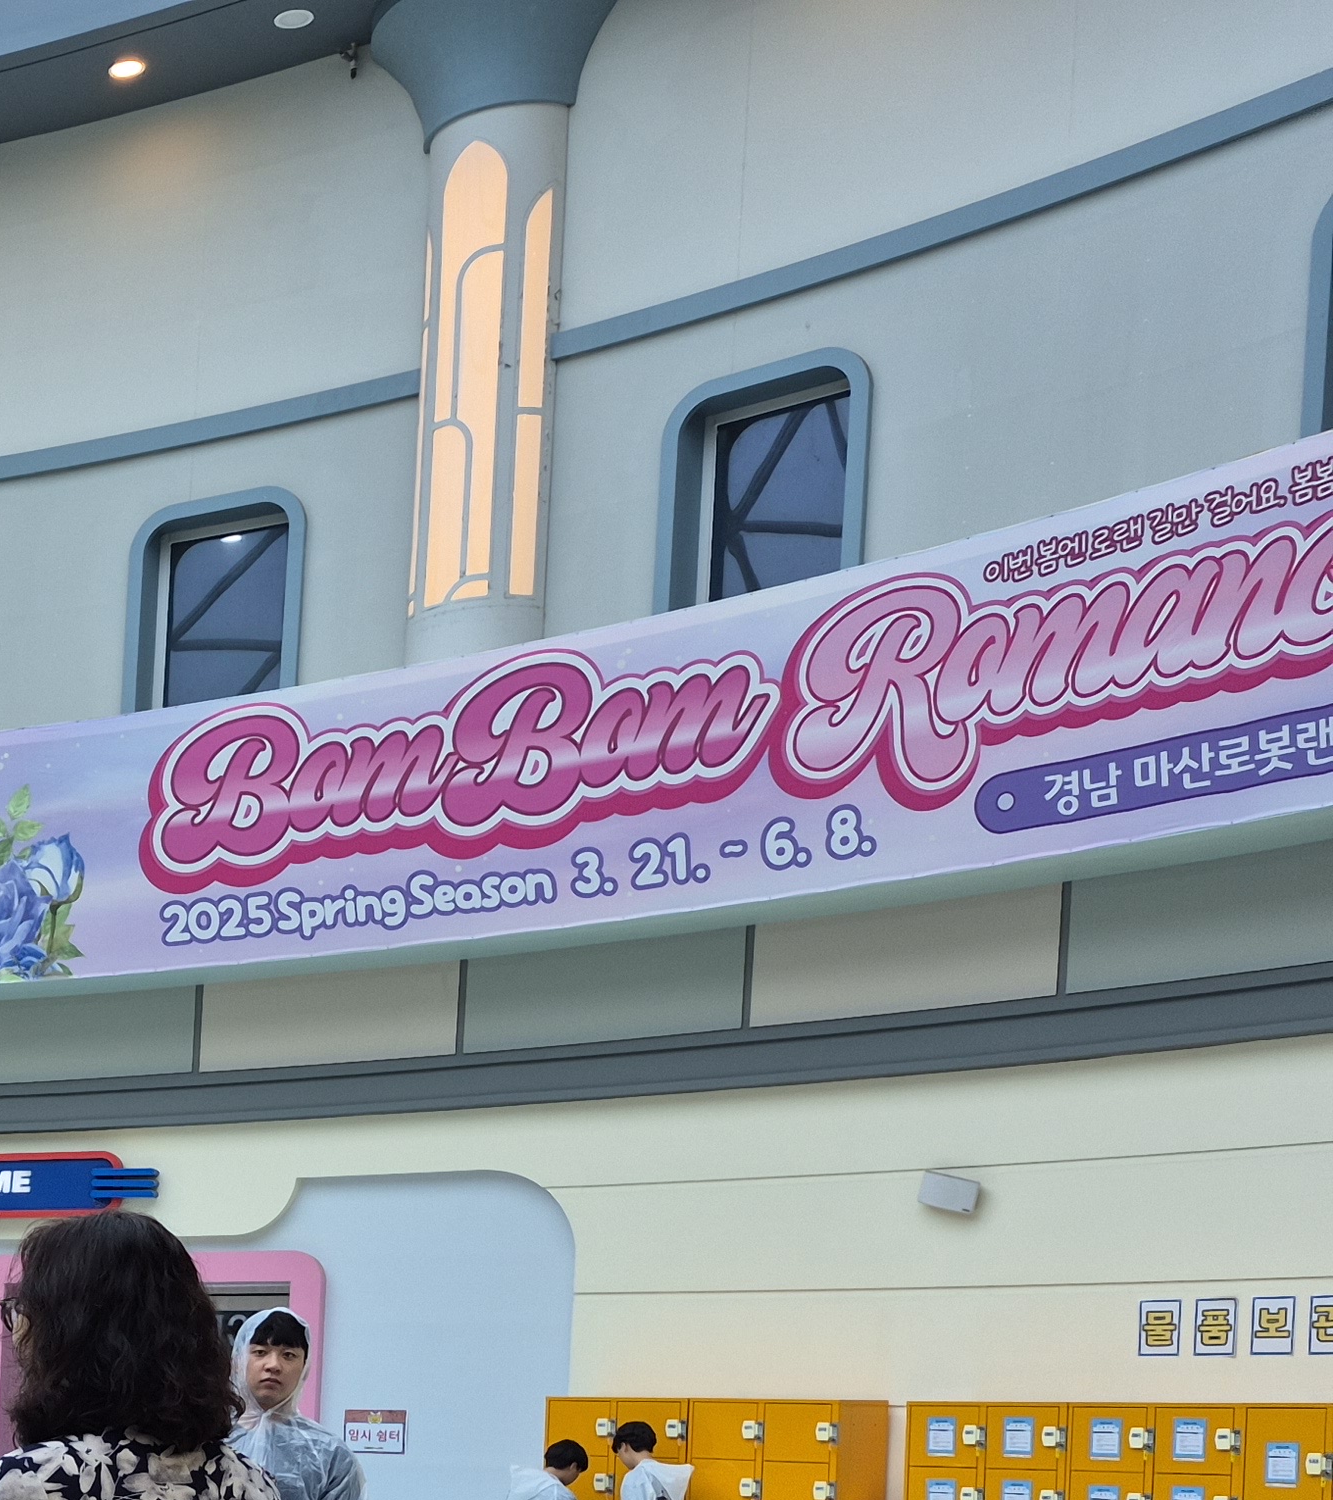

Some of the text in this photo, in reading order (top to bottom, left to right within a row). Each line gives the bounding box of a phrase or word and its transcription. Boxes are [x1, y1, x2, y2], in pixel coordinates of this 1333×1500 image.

[984, 546, 1034, 583] 이번
[1037, 529, 1088, 576] 봄엔
[1090, 514, 1144, 560] 로랜
[1147, 499, 1203, 545] 길만
[1044, 763, 1122, 816] 경남
[162, 894, 273, 945] 2025
[277, 886, 408, 938] Spring
[409, 869, 556, 915] Season
[571, 848, 618, 897] 3.
[629, 832, 711, 890] 21.
[761, 816, 812, 870] 6.
[826, 804, 877, 860] 8.
[348, 1428, 400, 1442] 임시 쉼터
